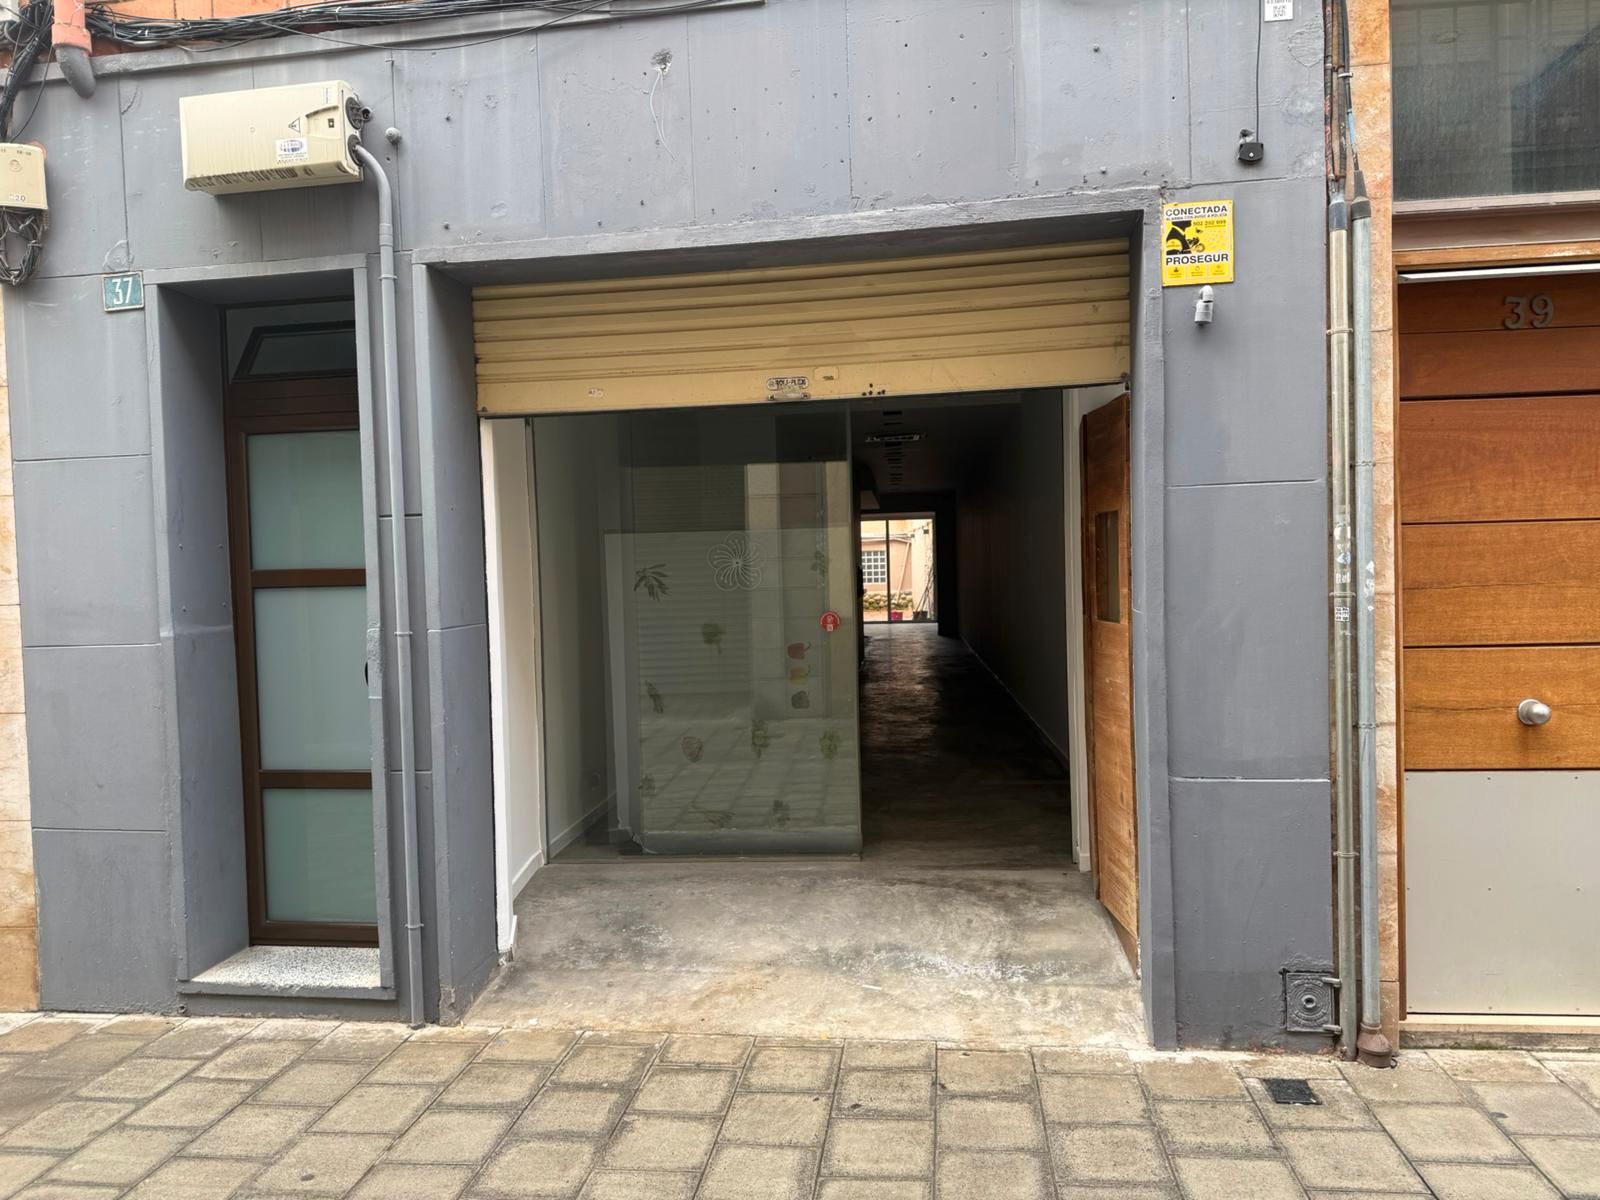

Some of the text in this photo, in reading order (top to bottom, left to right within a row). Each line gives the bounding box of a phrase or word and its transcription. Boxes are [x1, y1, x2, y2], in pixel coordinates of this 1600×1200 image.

[1165, 205, 1228, 217] CONECTADA
[1166, 253, 1229, 266] PROSEGUR
[112, 277, 133, 305] 37
[1504, 295, 1554, 330] 39
